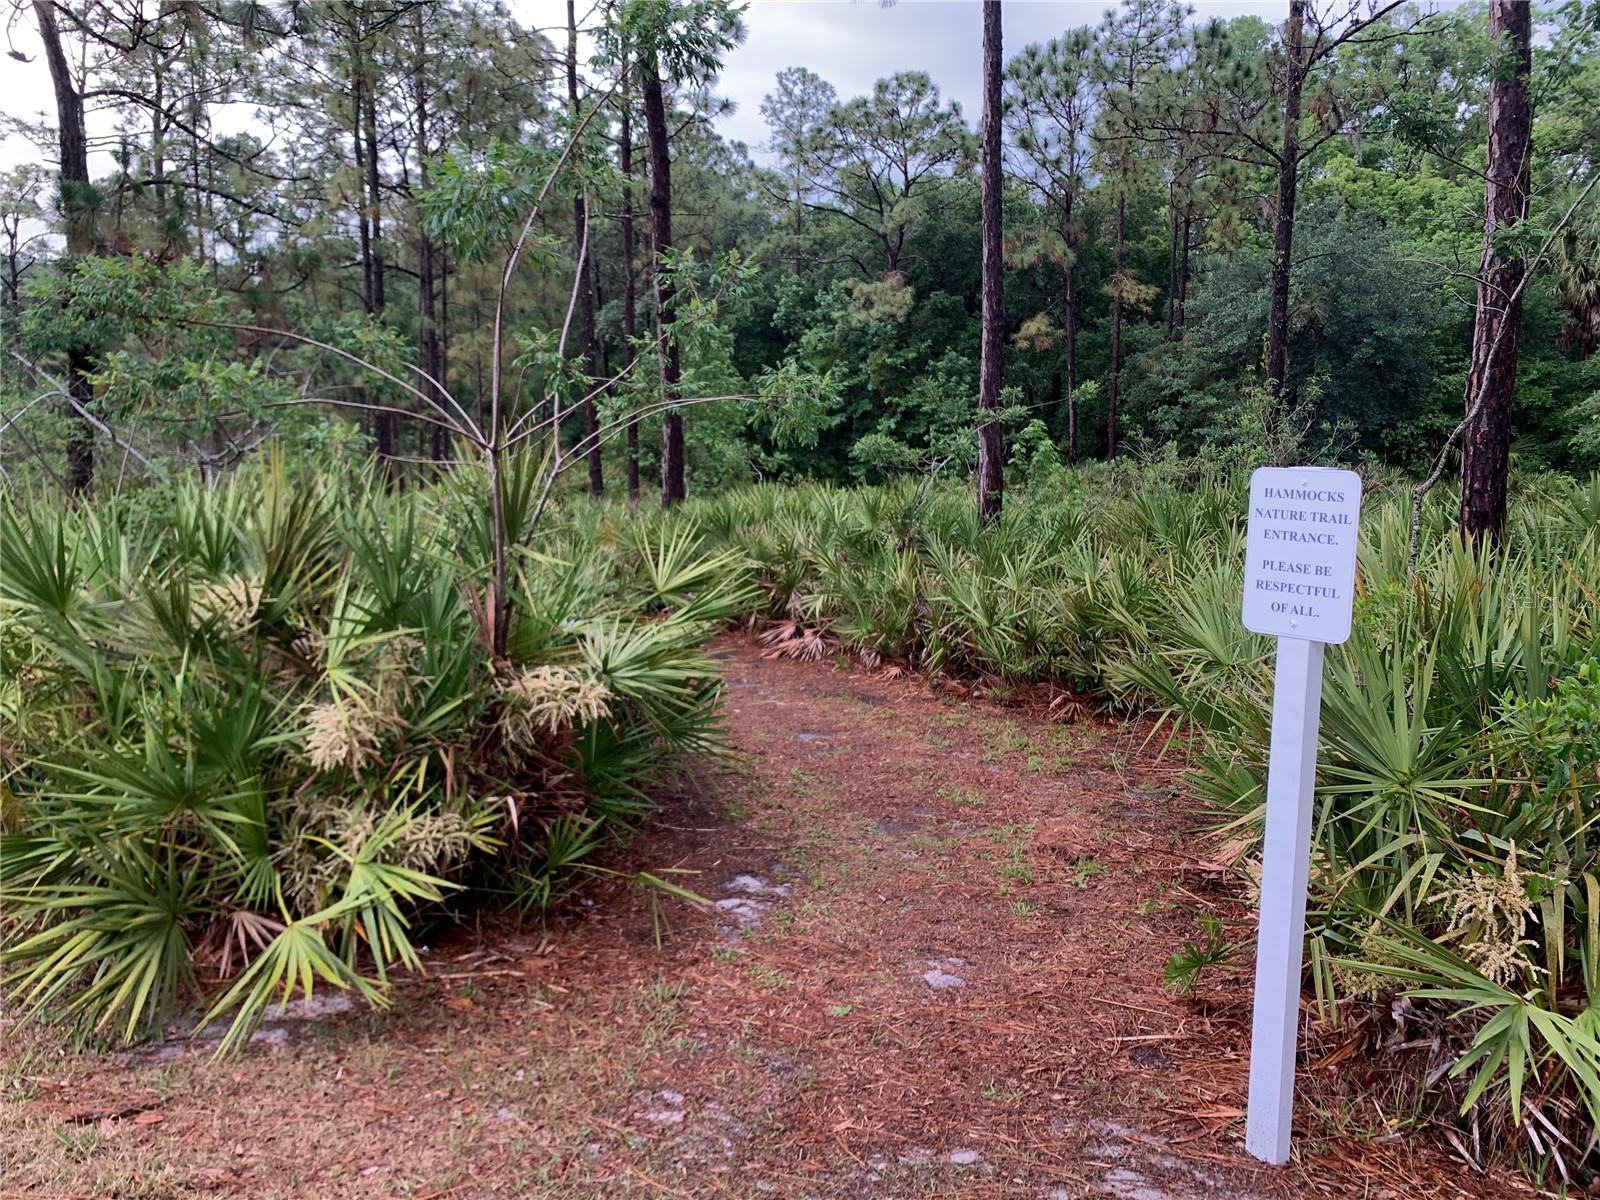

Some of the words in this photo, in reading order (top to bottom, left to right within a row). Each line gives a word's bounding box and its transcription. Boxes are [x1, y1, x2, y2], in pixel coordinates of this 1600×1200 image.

[1264, 487, 1345, 503] HAMMOCKS
[1255, 507, 1307, 521] NATURE
[1310, 511, 1352, 525] TRAIL
[1263, 528, 1339, 546] ENTRANCE.
[1262, 559, 1311, 575] PLEASE
[1315, 565, 1332, 577] BE
[1255, 579, 1340, 599] RESPECTFUL
[1270, 601, 1289, 613] OF
[1290, 604, 1320, 618] ALL.
